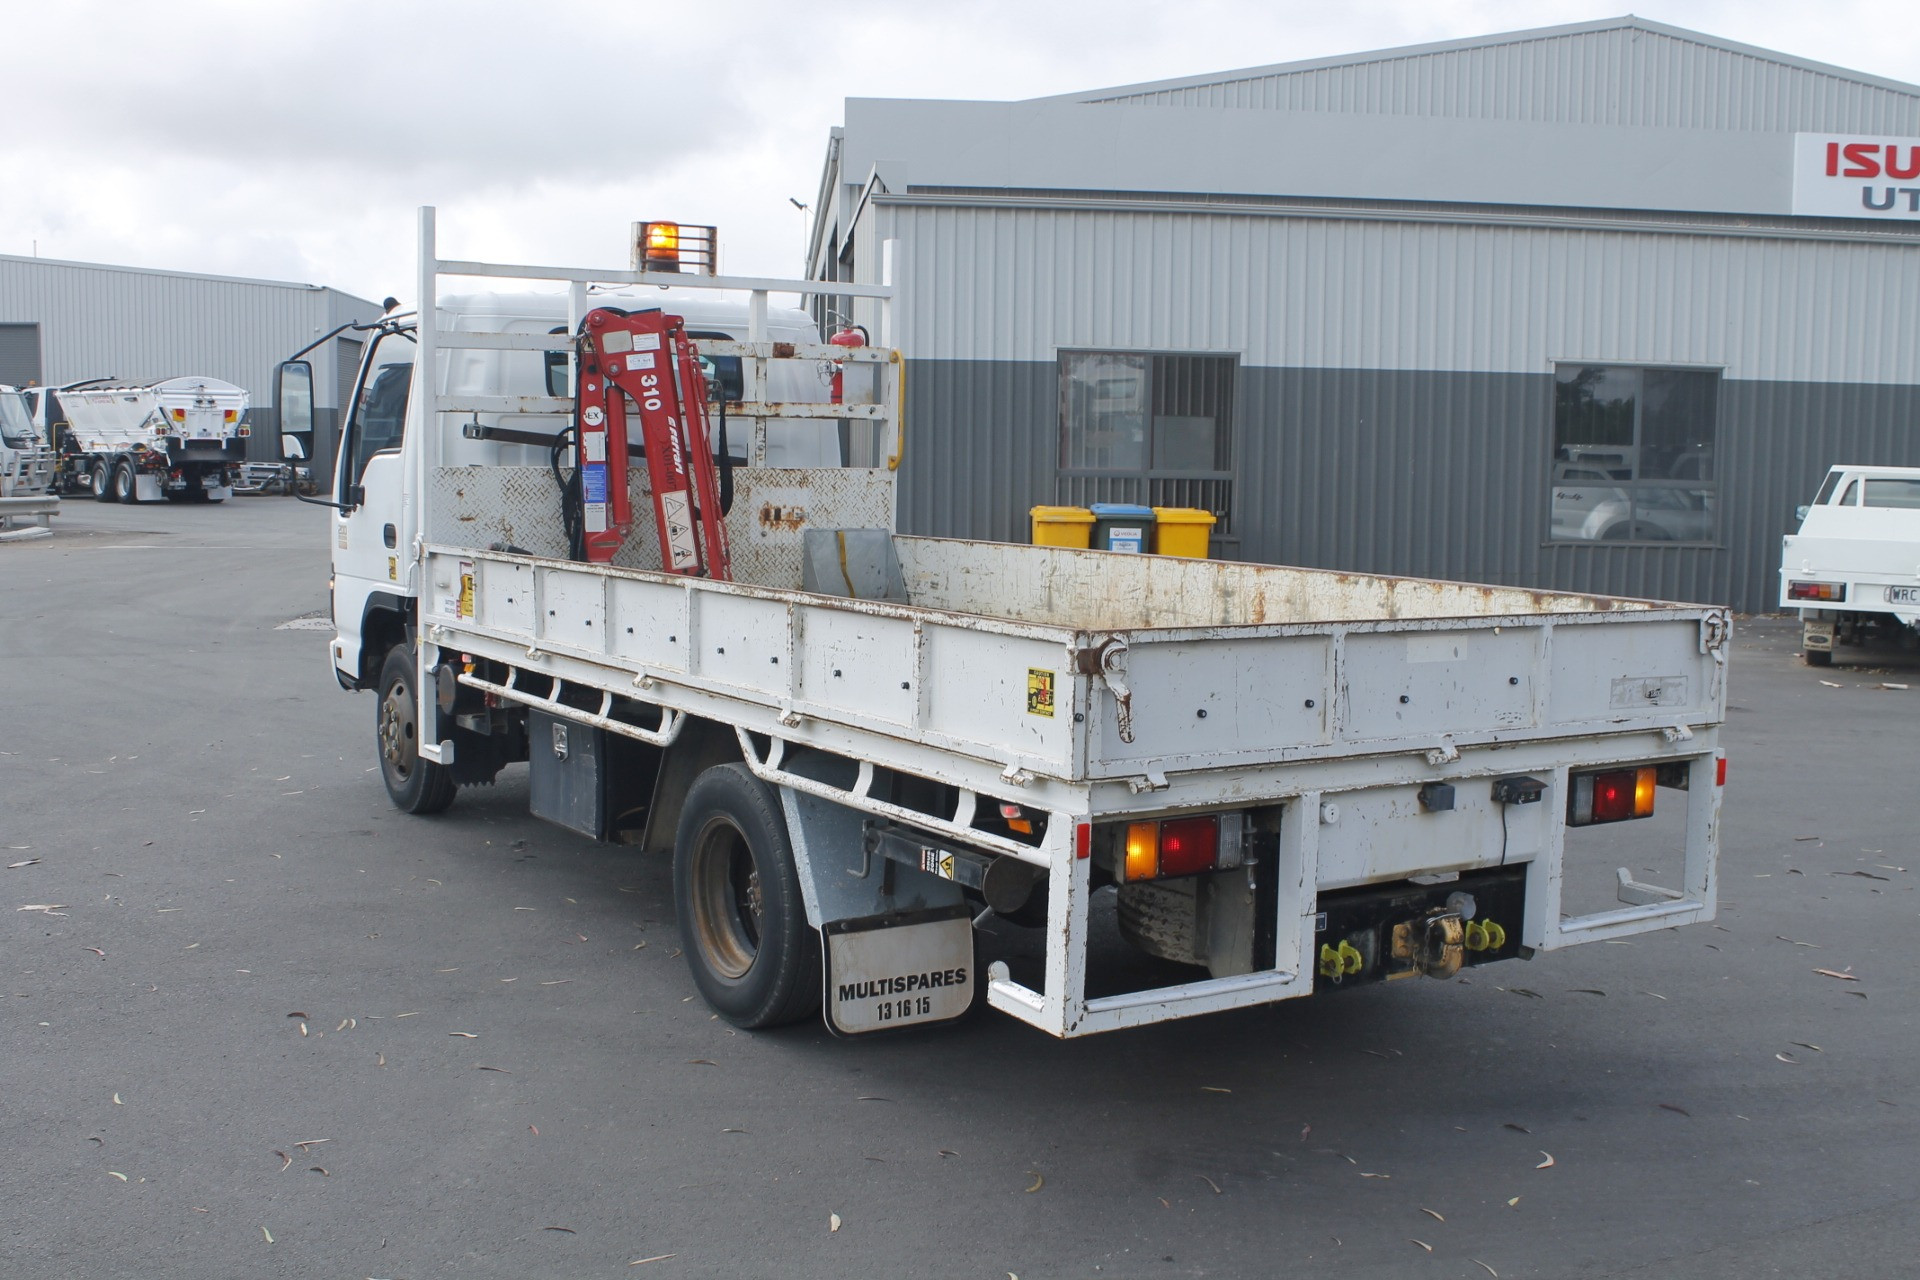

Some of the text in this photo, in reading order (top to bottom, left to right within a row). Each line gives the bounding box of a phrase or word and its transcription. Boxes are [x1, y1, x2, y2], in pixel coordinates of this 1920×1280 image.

[641, 374, 661, 411] 310
[1893, 589, 1917, 601] WRC
[839, 968, 967, 1001] MULTISPARES
[877, 996, 930, 1021] 13 16 15
